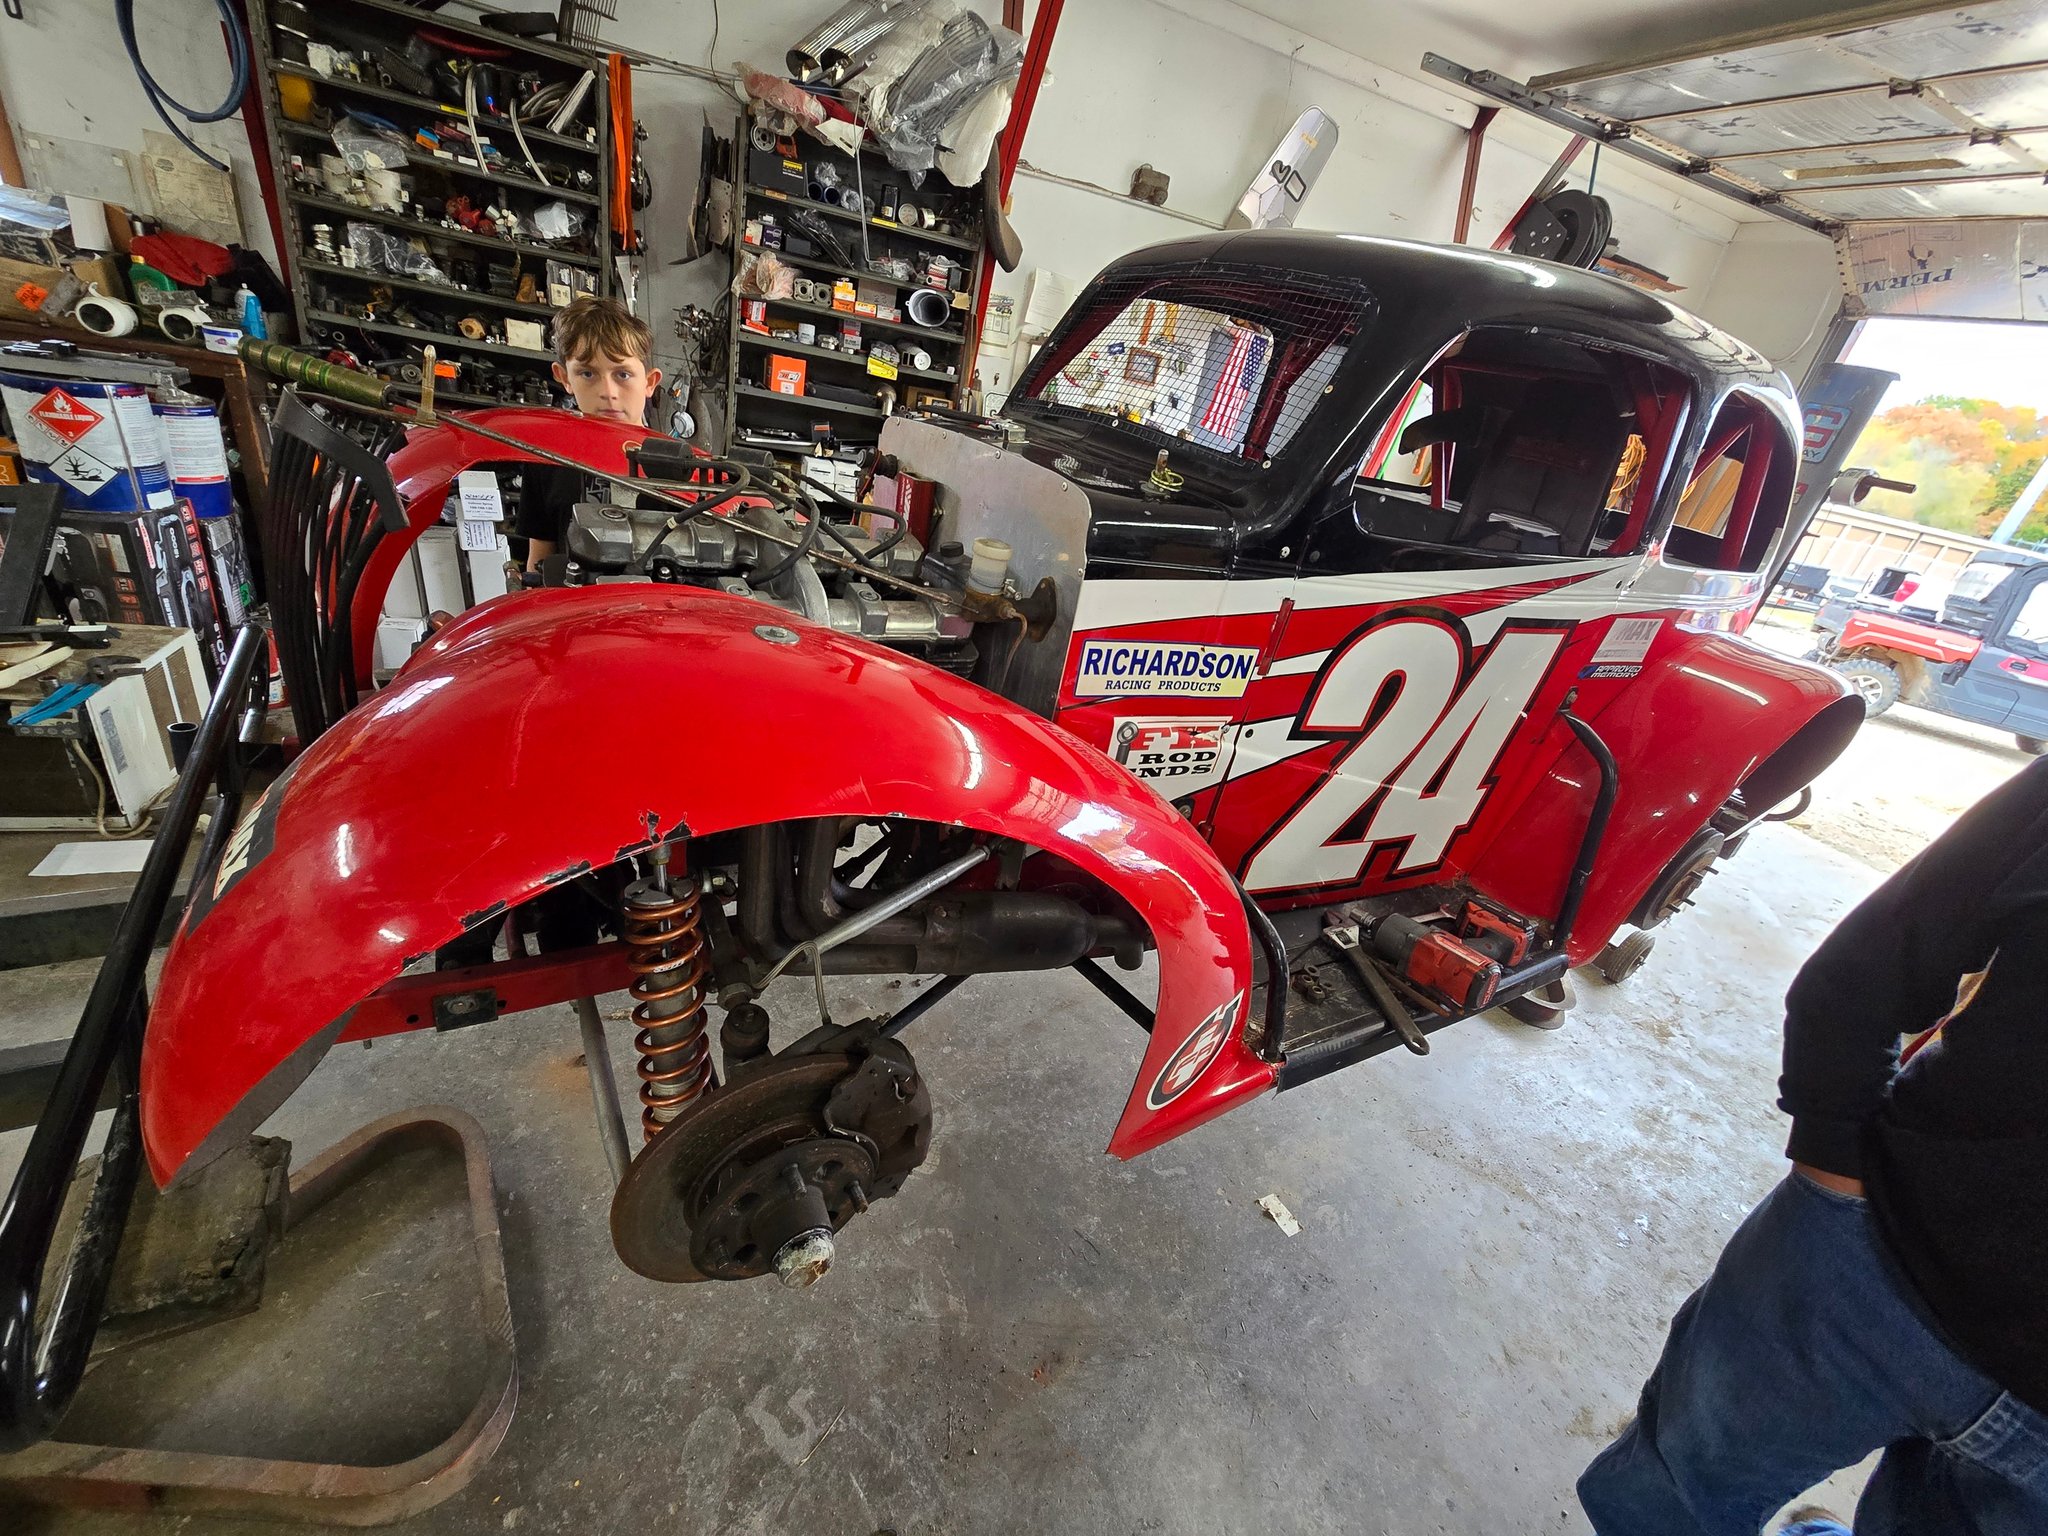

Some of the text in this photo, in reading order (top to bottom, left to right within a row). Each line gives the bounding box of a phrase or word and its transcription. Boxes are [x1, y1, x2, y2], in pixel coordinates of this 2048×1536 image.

[1084, 648, 1254, 680] RICHARDSON
[1105, 680, 1222, 692] RACING PRODUCTS
[1138, 751, 1217, 765] ROD
[1238, 607, 1578, 897] 24
